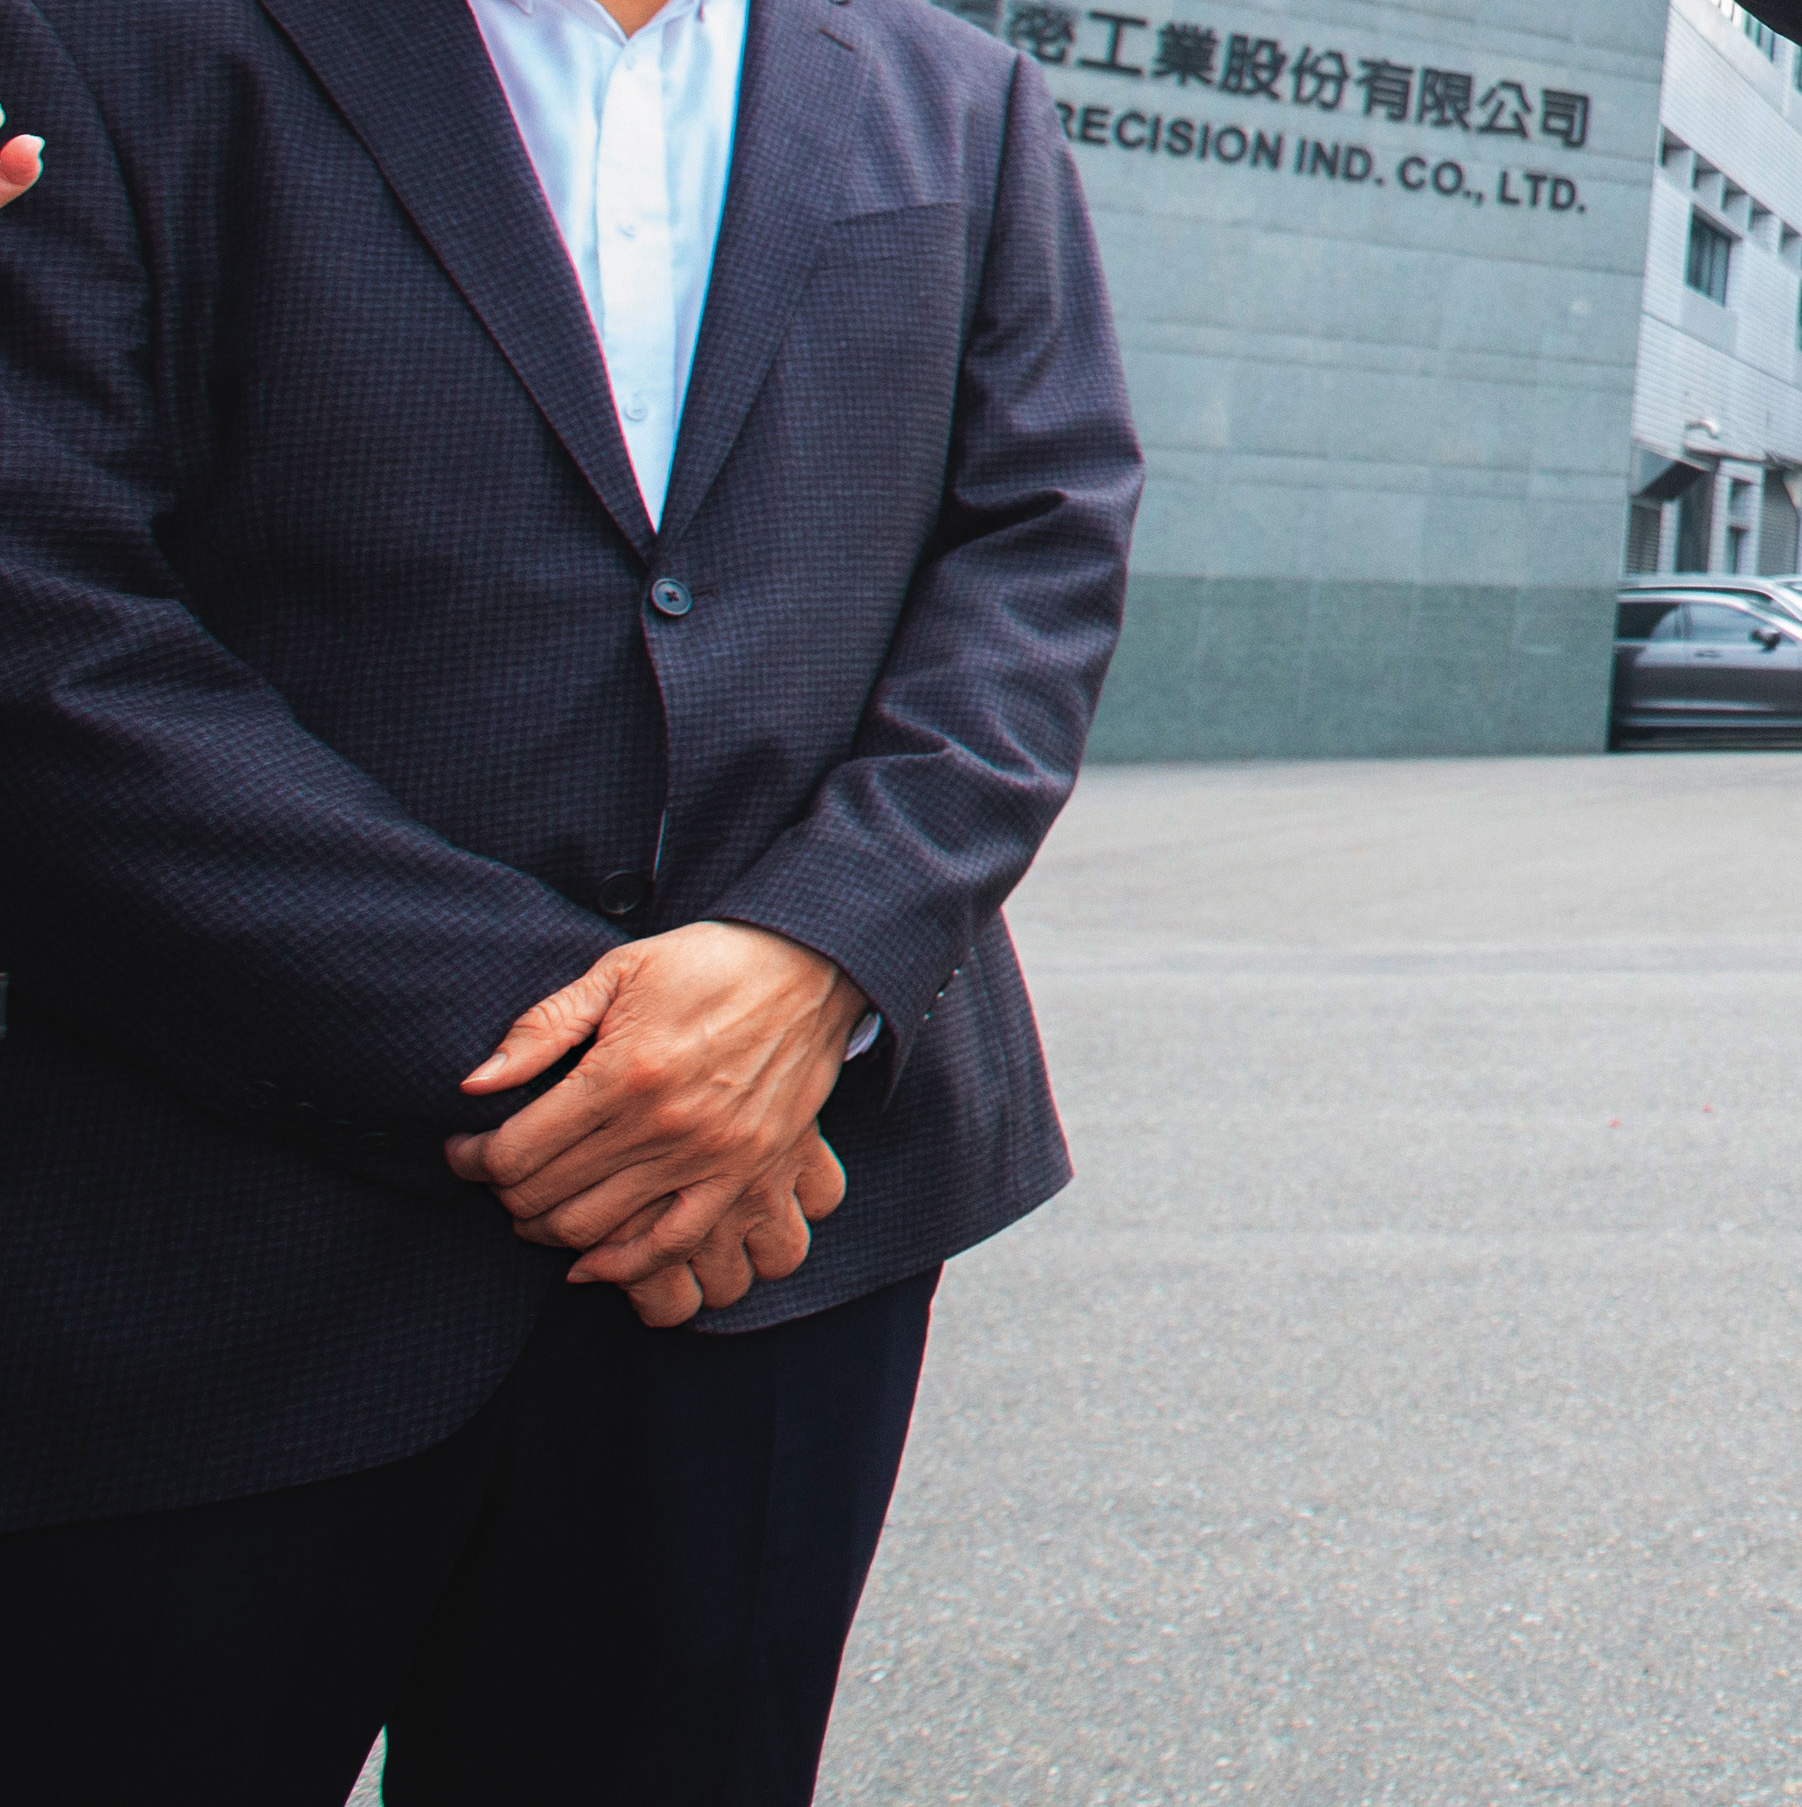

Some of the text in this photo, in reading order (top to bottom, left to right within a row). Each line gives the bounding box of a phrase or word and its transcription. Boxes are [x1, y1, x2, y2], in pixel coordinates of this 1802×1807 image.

[1295, 139, 1385, 186] IND.
[1397, 155, 1485, 206] CO.,
[1498, 169, 1587, 214] LTD.
